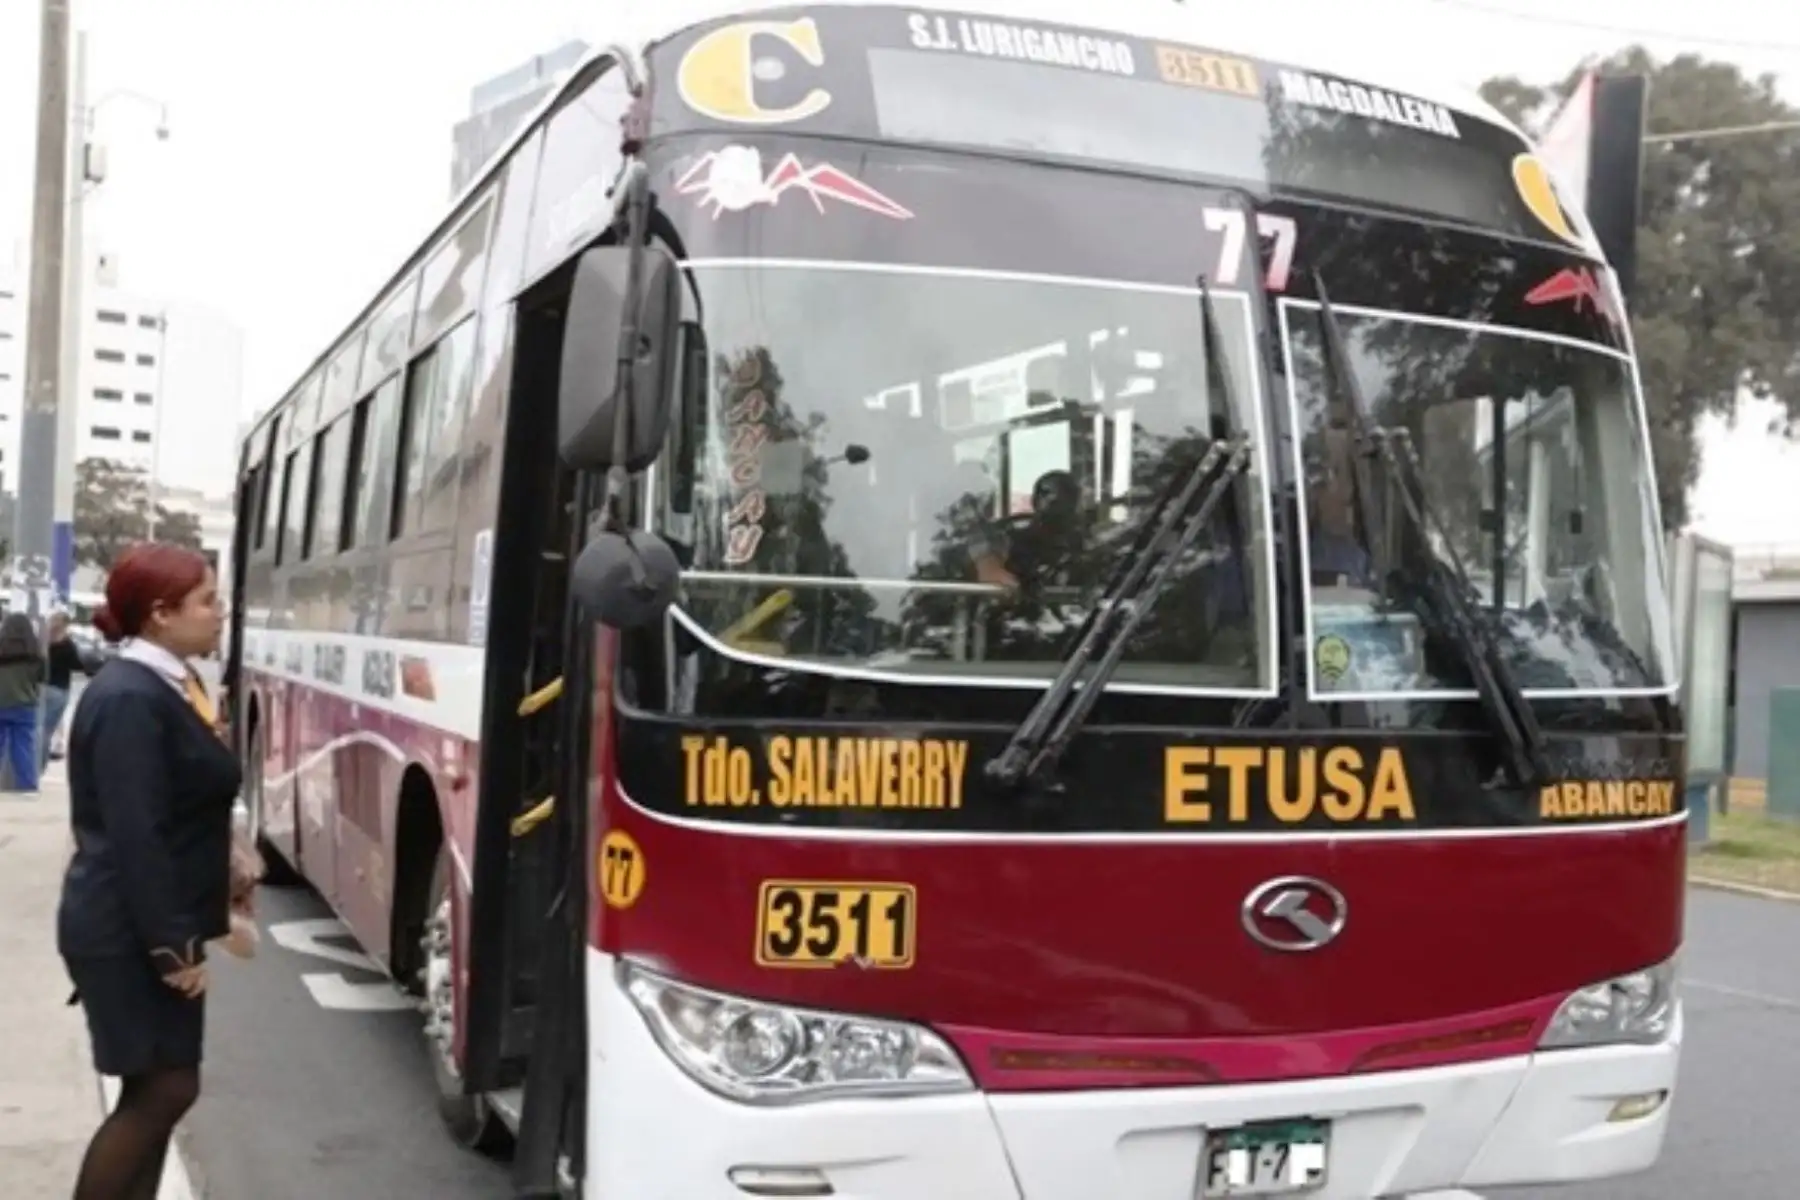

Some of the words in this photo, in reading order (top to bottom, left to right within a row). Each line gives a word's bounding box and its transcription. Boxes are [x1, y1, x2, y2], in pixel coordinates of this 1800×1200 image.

[958, 19, 1135, 76] LURIGANCHO
[1164, 50, 1252, 91] 3511
[1278, 69, 1460, 138] MAGDALENA
[682, 736, 760, 805] Tdo.
[768, 736, 968, 809] SALAVERRY
[1164, 747, 1415, 822] ETUSA
[1540, 780, 1676, 817] ABANCAY
[604, 846, 634, 898] 77
[769, 889, 906, 957] 3511
